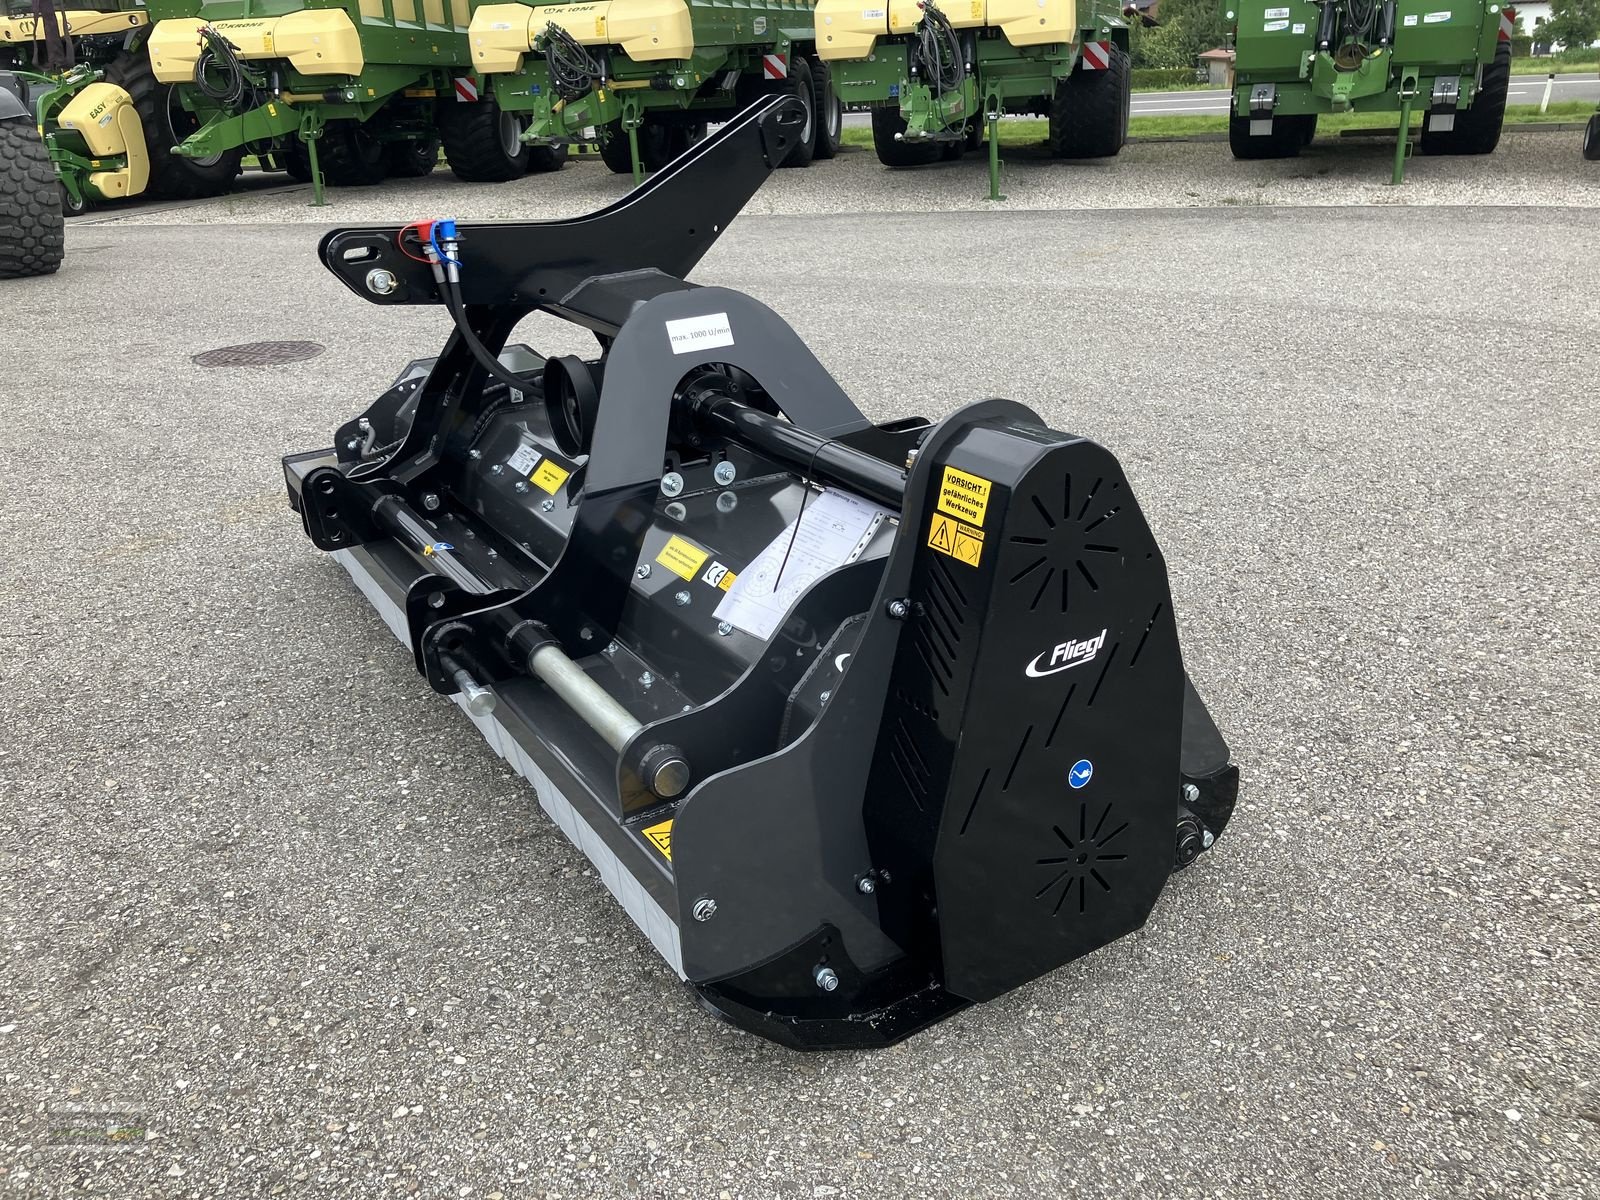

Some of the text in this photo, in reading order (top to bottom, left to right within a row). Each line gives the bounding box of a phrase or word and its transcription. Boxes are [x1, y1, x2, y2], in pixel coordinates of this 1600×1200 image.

[555, 6, 597, 14] KONE
[89, 101, 107, 119] EASY
[690, 329, 707, 339] 1000
[708, 327, 730, 337] U/min
[947, 474, 983, 493] VORSICHT
[943, 488, 984, 509] gefährliches
[945, 498, 977, 518] Werkzeug
[1049, 628, 1108, 666] Fliegl
